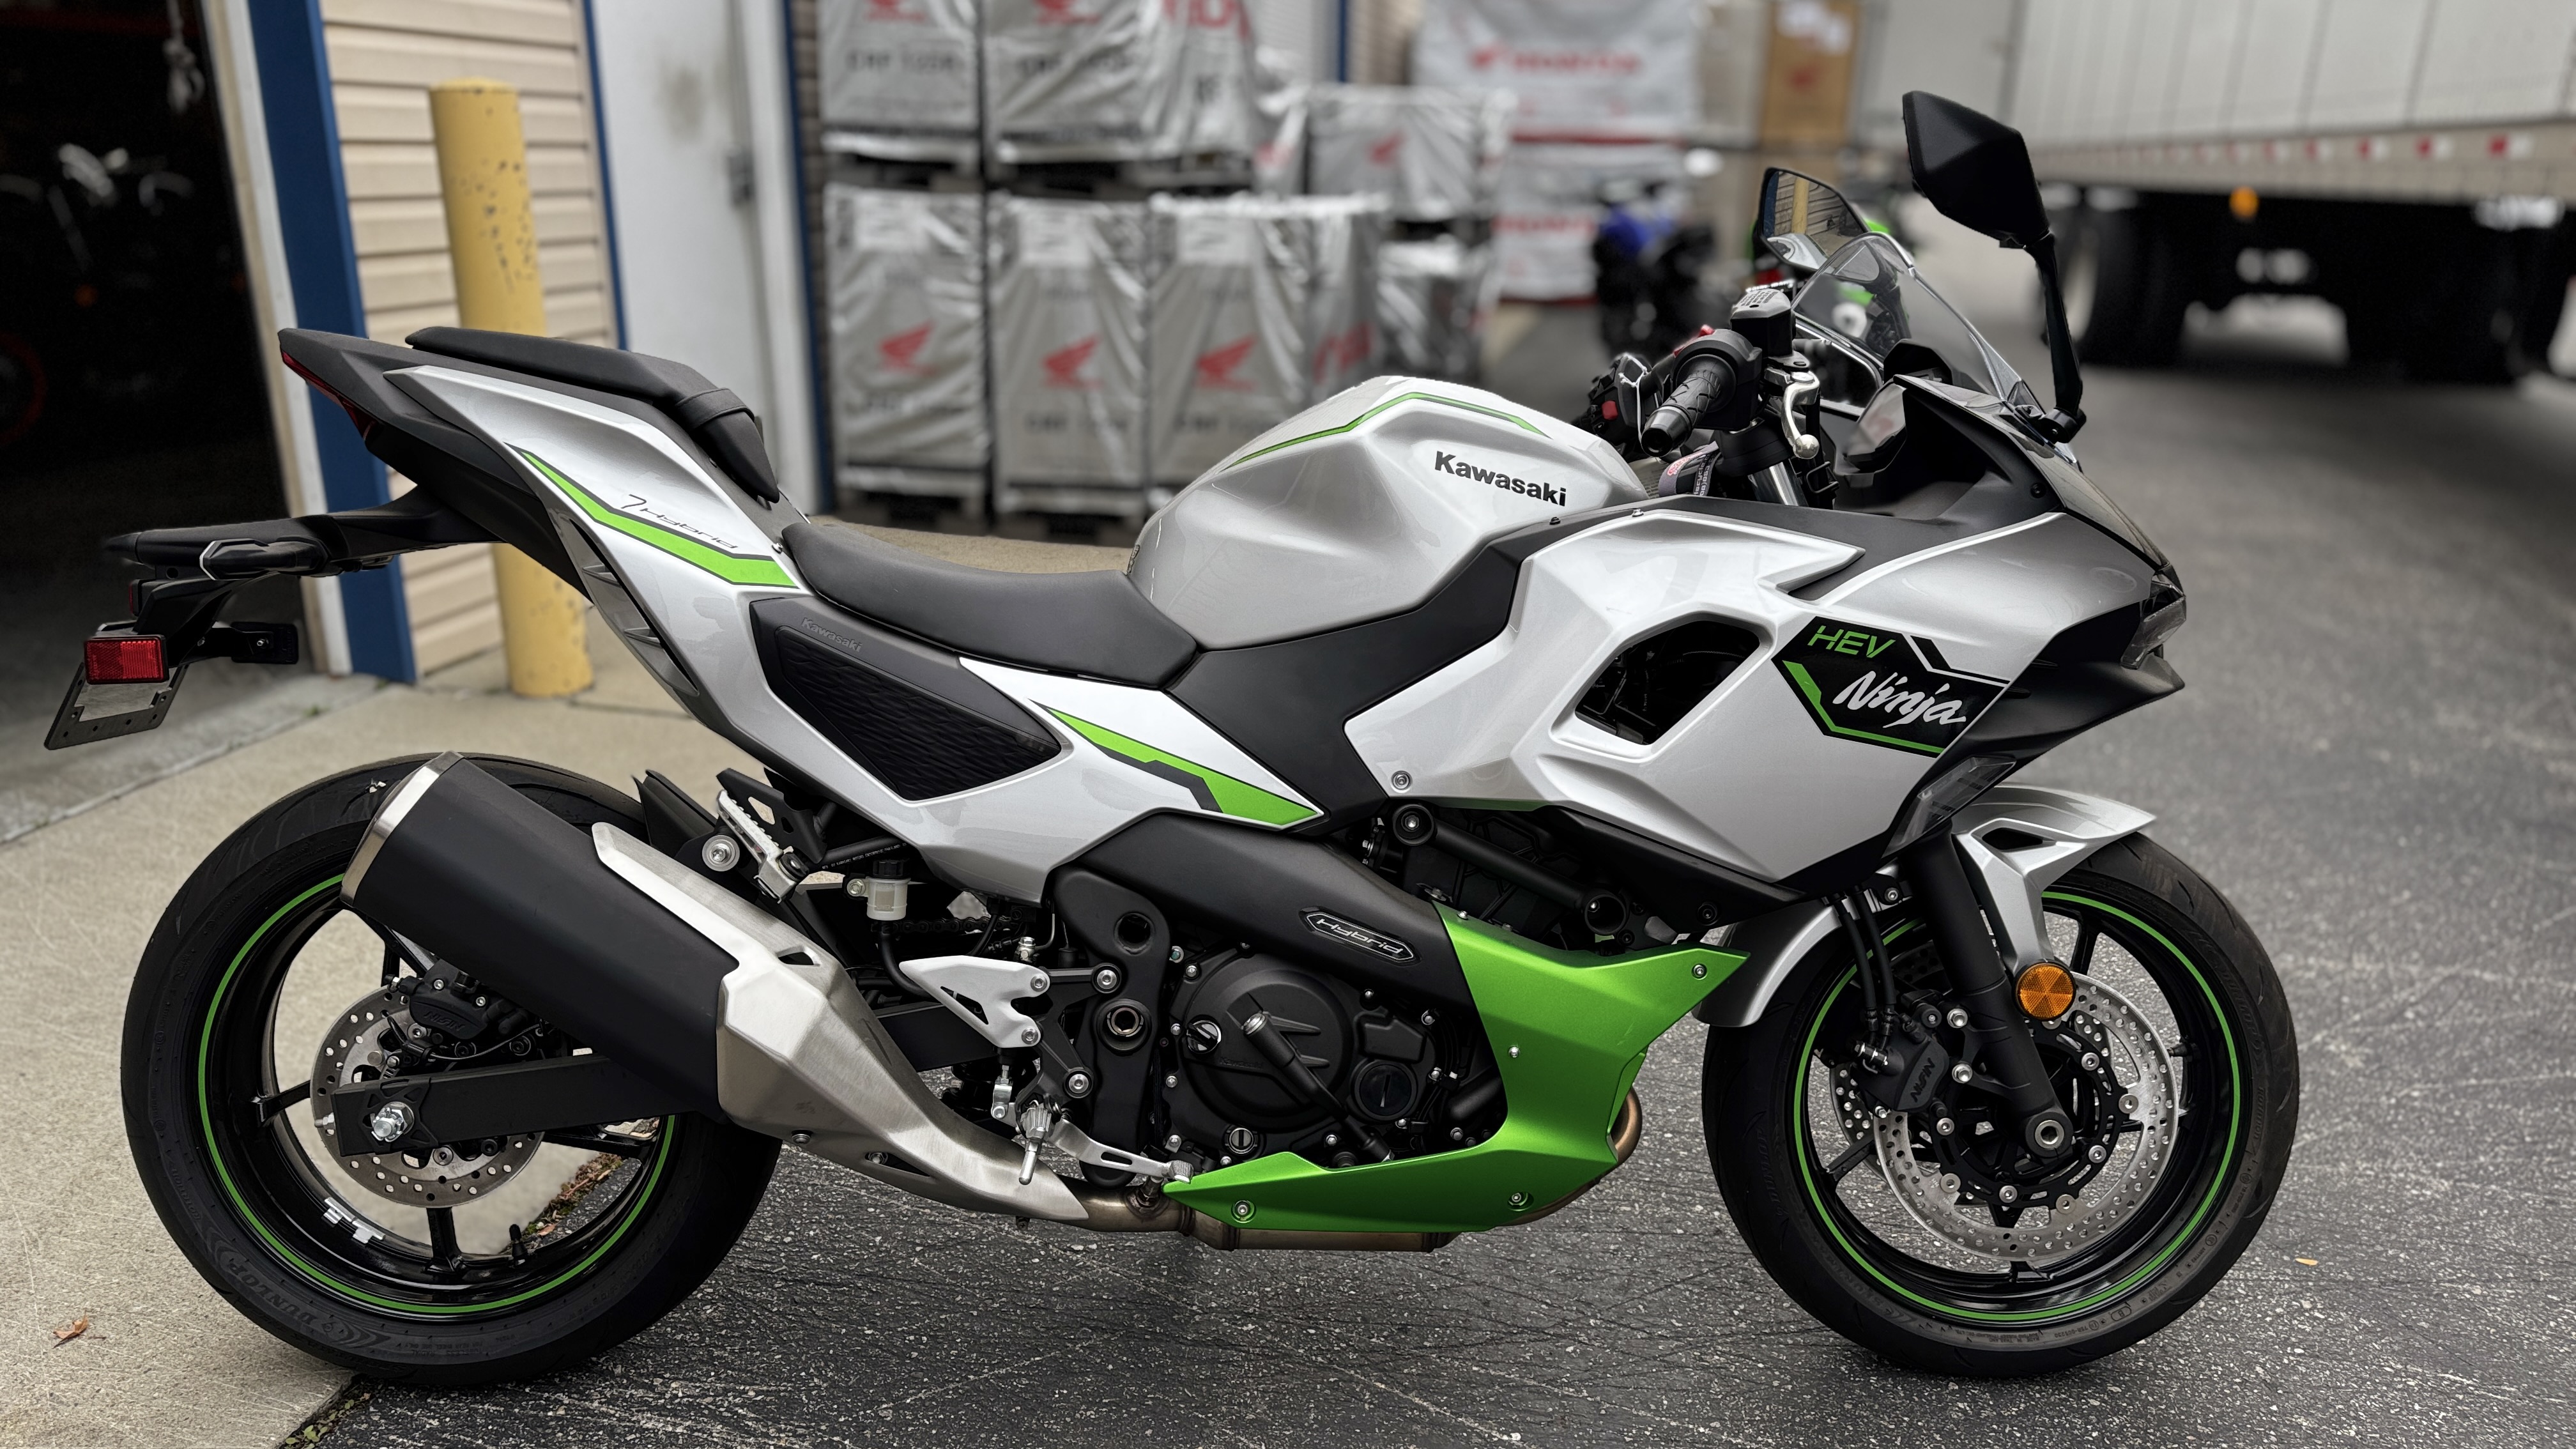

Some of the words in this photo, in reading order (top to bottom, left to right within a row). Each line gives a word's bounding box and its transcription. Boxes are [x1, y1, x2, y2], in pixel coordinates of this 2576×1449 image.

[1434, 451, 1567, 507] Kawasaki
[620, 494, 647, 509] 7
[640, 508, 739, 549] Hybrid
[801, 617, 863, 652] Kawasaki
[1807, 625, 1896, 659] HEV
[1832, 670, 1966, 728] Ninja
[1316, 918, 1402, 955] Hybrid
[225, 1257, 318, 1326] DUNLOP
